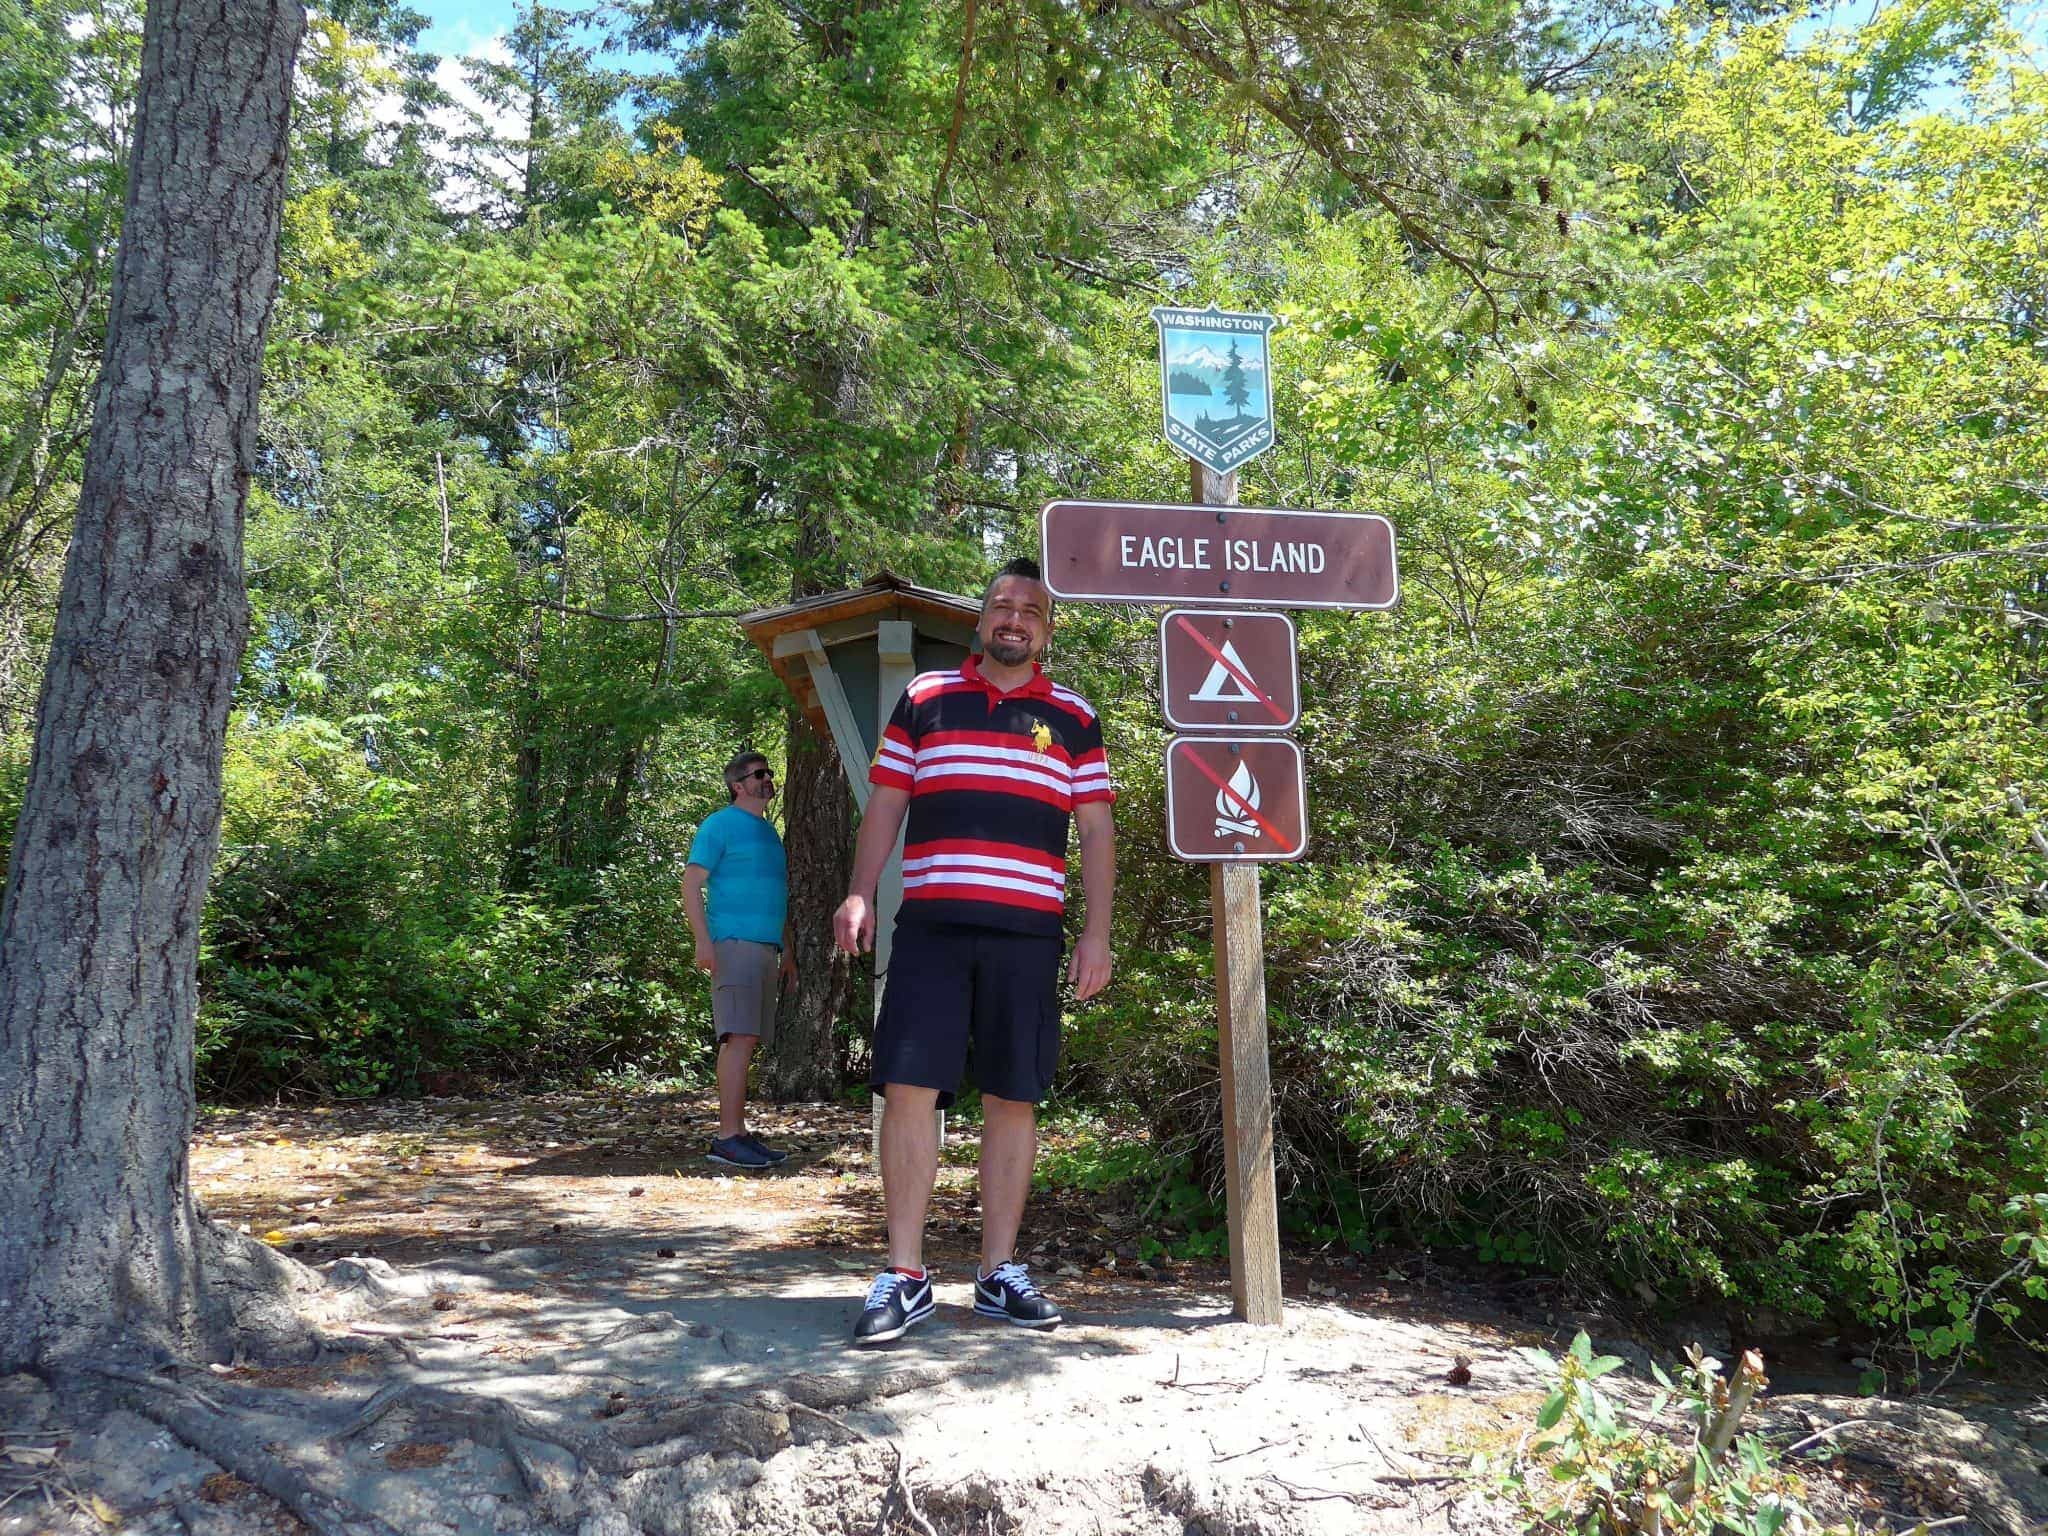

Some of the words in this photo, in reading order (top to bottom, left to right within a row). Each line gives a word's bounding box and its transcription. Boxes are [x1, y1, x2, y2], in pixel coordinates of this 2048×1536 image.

[1161, 313, 1265, 331] WASHINGTON
[1168, 422, 1217, 462] STATE
[1221, 427, 1270, 464] PARKS
[1120, 535, 1211, 570] EAGLE
[1224, 539, 1325, 574] ISLAND
